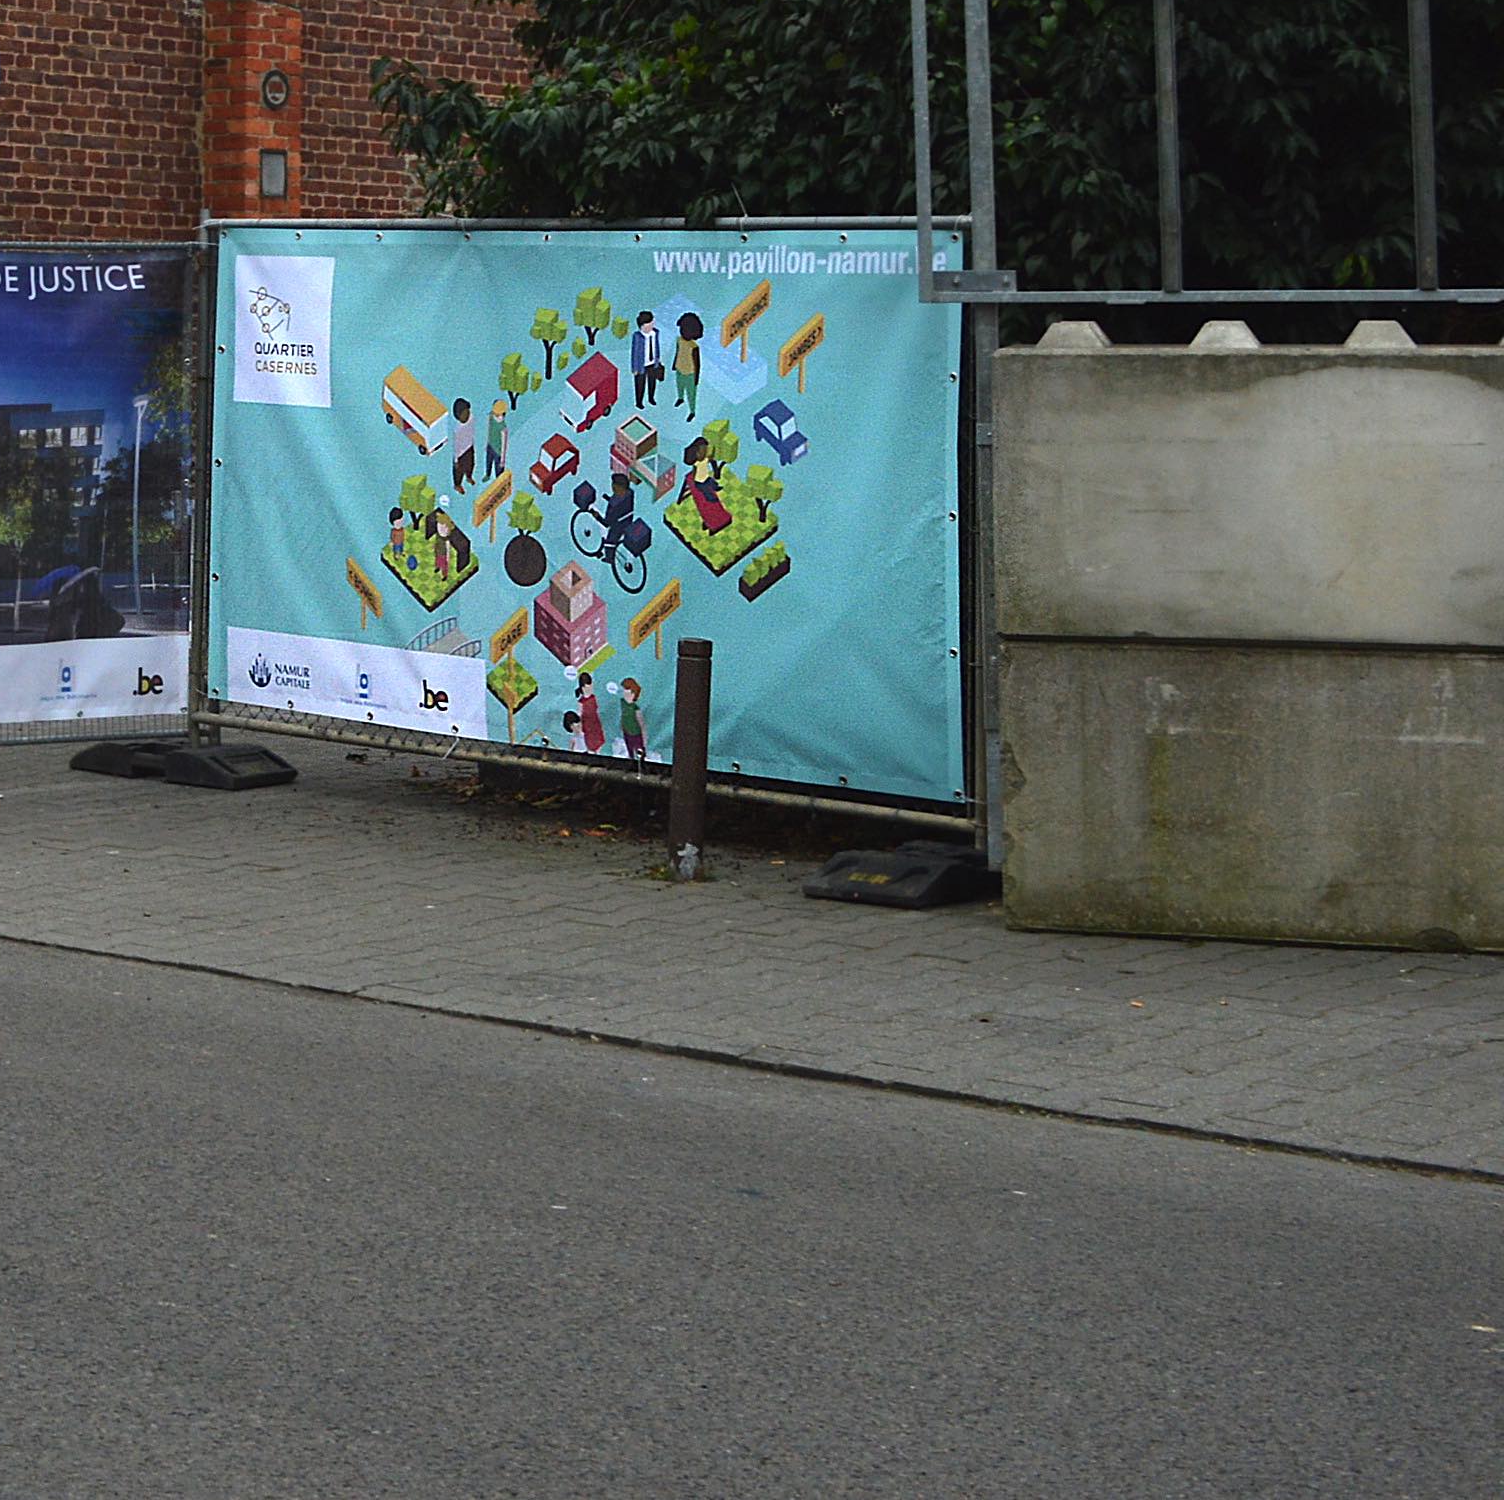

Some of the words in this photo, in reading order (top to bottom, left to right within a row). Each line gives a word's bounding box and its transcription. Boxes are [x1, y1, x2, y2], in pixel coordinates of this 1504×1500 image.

[28, 263, 146, 300] JUSTICE
[254, 342, 314, 357] QUARTIER
[255, 360, 317, 375] CASERNES
[275, 663, 309, 677] NAMUR
[133, 667, 163, 696] .be
[275, 676, 310, 689] CAPITALE
[419, 679, 448, 711] .be
